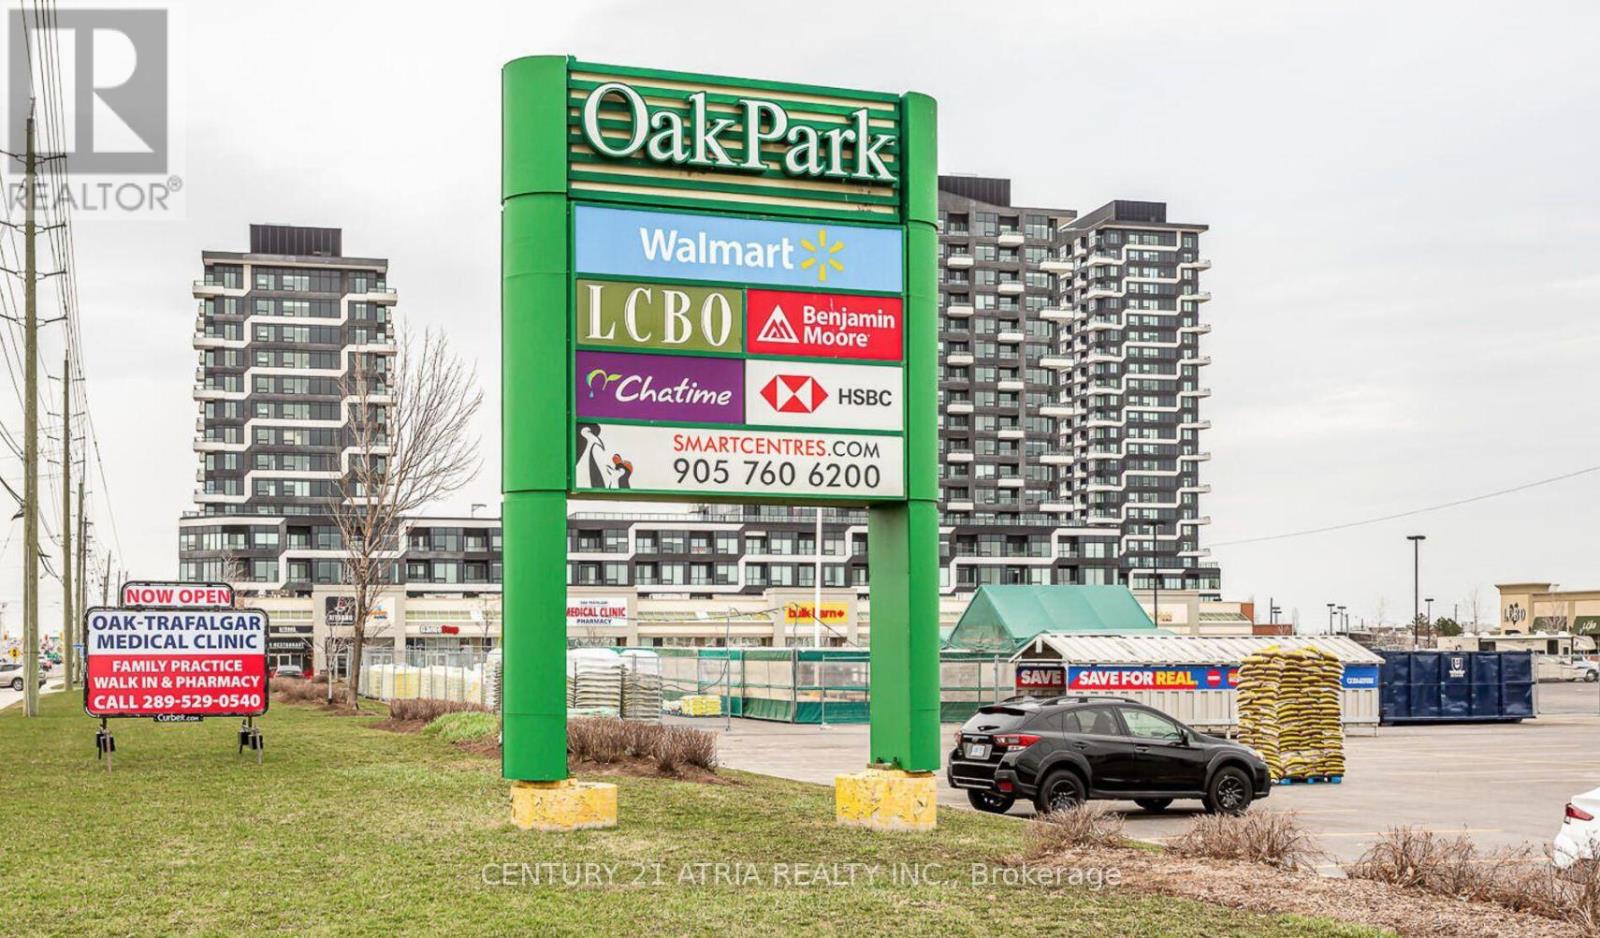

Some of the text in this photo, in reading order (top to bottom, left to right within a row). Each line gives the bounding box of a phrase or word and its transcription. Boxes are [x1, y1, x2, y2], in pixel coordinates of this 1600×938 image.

[584, 82, 898, 182] Oak Park
[639, 227, 795, 269] Walmart
[585, 285, 733, 347] LCBO
[803, 305, 896, 331] Benjamin
[803, 326, 869, 348] Moore
[615, 375, 732, 406] Chatime
[838, 388, 892, 407] HSBC
[673, 434, 880, 459] SMARTCENTRES.COM
[673, 458, 881, 488] 905 760 6200
[126, 589, 231, 604] NOW OPEN
[600, 607, 626, 617] CLINIC
[92, 615, 261, 631] OAK-TRAFALGAR
[97, 634, 257, 649] MEDICAL CLINIC
[112, 659, 242, 672] FAMILY PRACTICE
[93, 675, 260, 689] WALK IN & PHARMACY
[1021, 670, 1062, 684] SAVE
[1079, 671, 1119, 685] SAVE
[1121, 671, 1153, 685] FOR
[94, 694, 261, 710] CALL 289-529-0540
